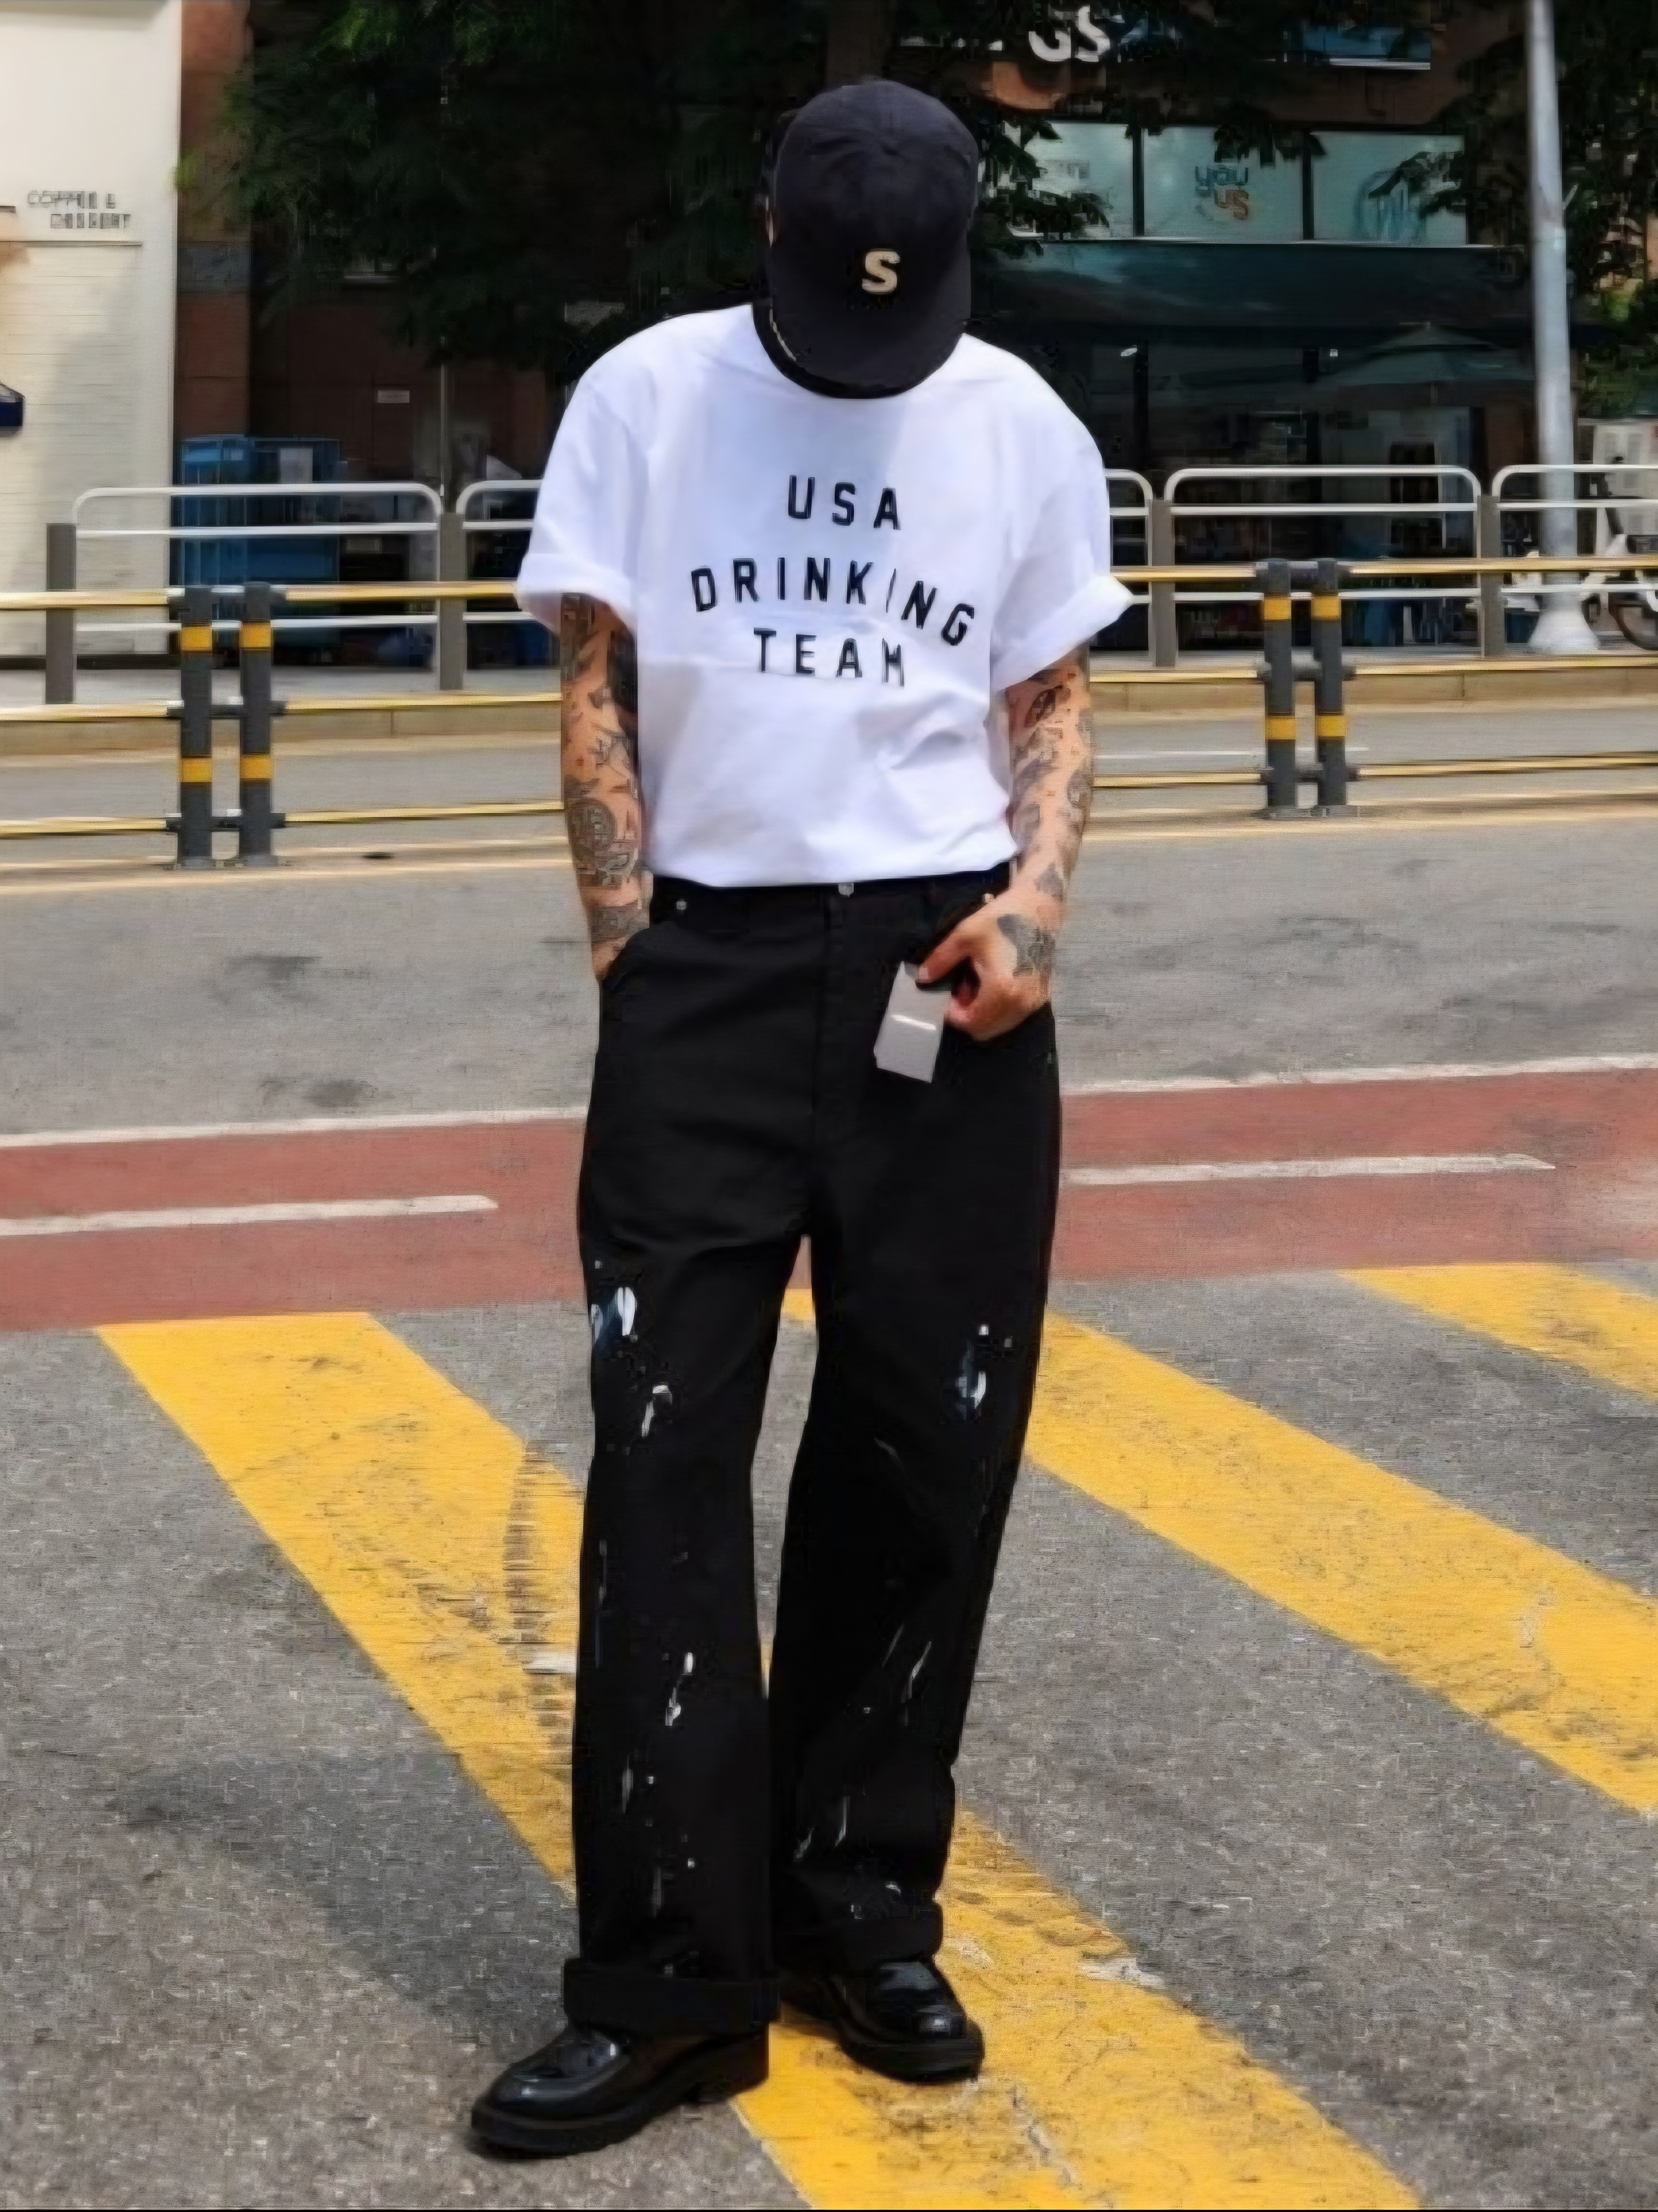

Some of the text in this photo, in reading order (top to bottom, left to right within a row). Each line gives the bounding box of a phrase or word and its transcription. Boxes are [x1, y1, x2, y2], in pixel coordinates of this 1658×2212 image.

[862, 248, 900, 295] S
[788, 474, 901, 531] USA
[691, 557, 975, 646] DRINKING
[753, 627, 905, 687] TEAM
